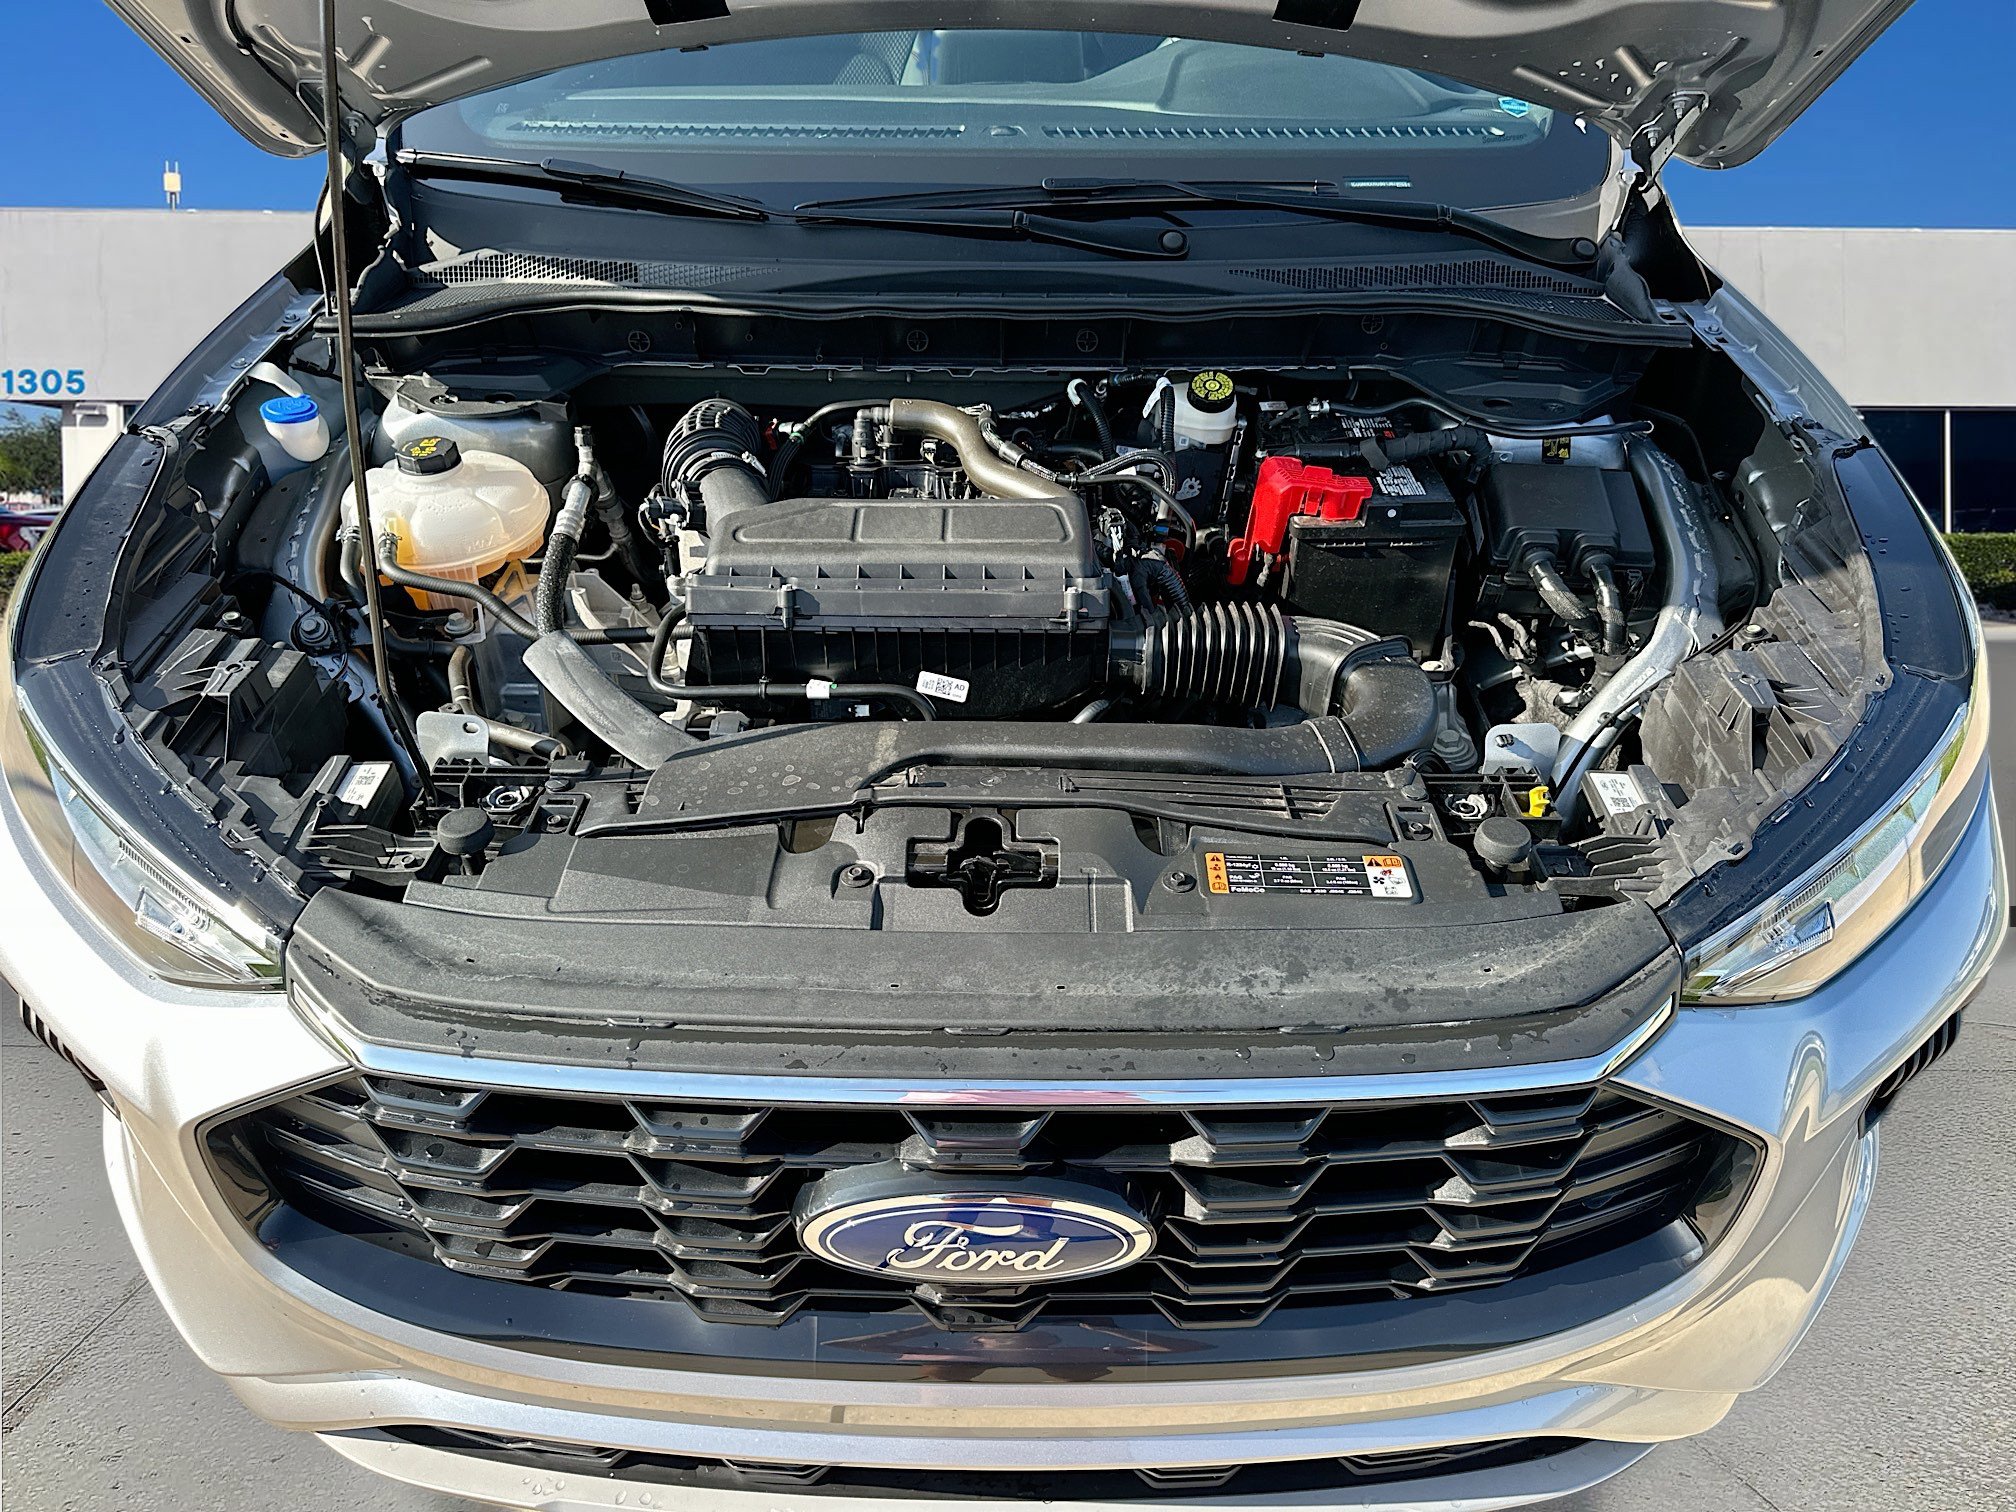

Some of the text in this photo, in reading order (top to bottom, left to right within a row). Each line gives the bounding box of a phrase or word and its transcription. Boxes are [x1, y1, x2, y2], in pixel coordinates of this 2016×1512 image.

[1, 369, 85, 394] 1305
[954, 683, 965, 691] AD
[886, 1220, 1070, 1272] Ford
